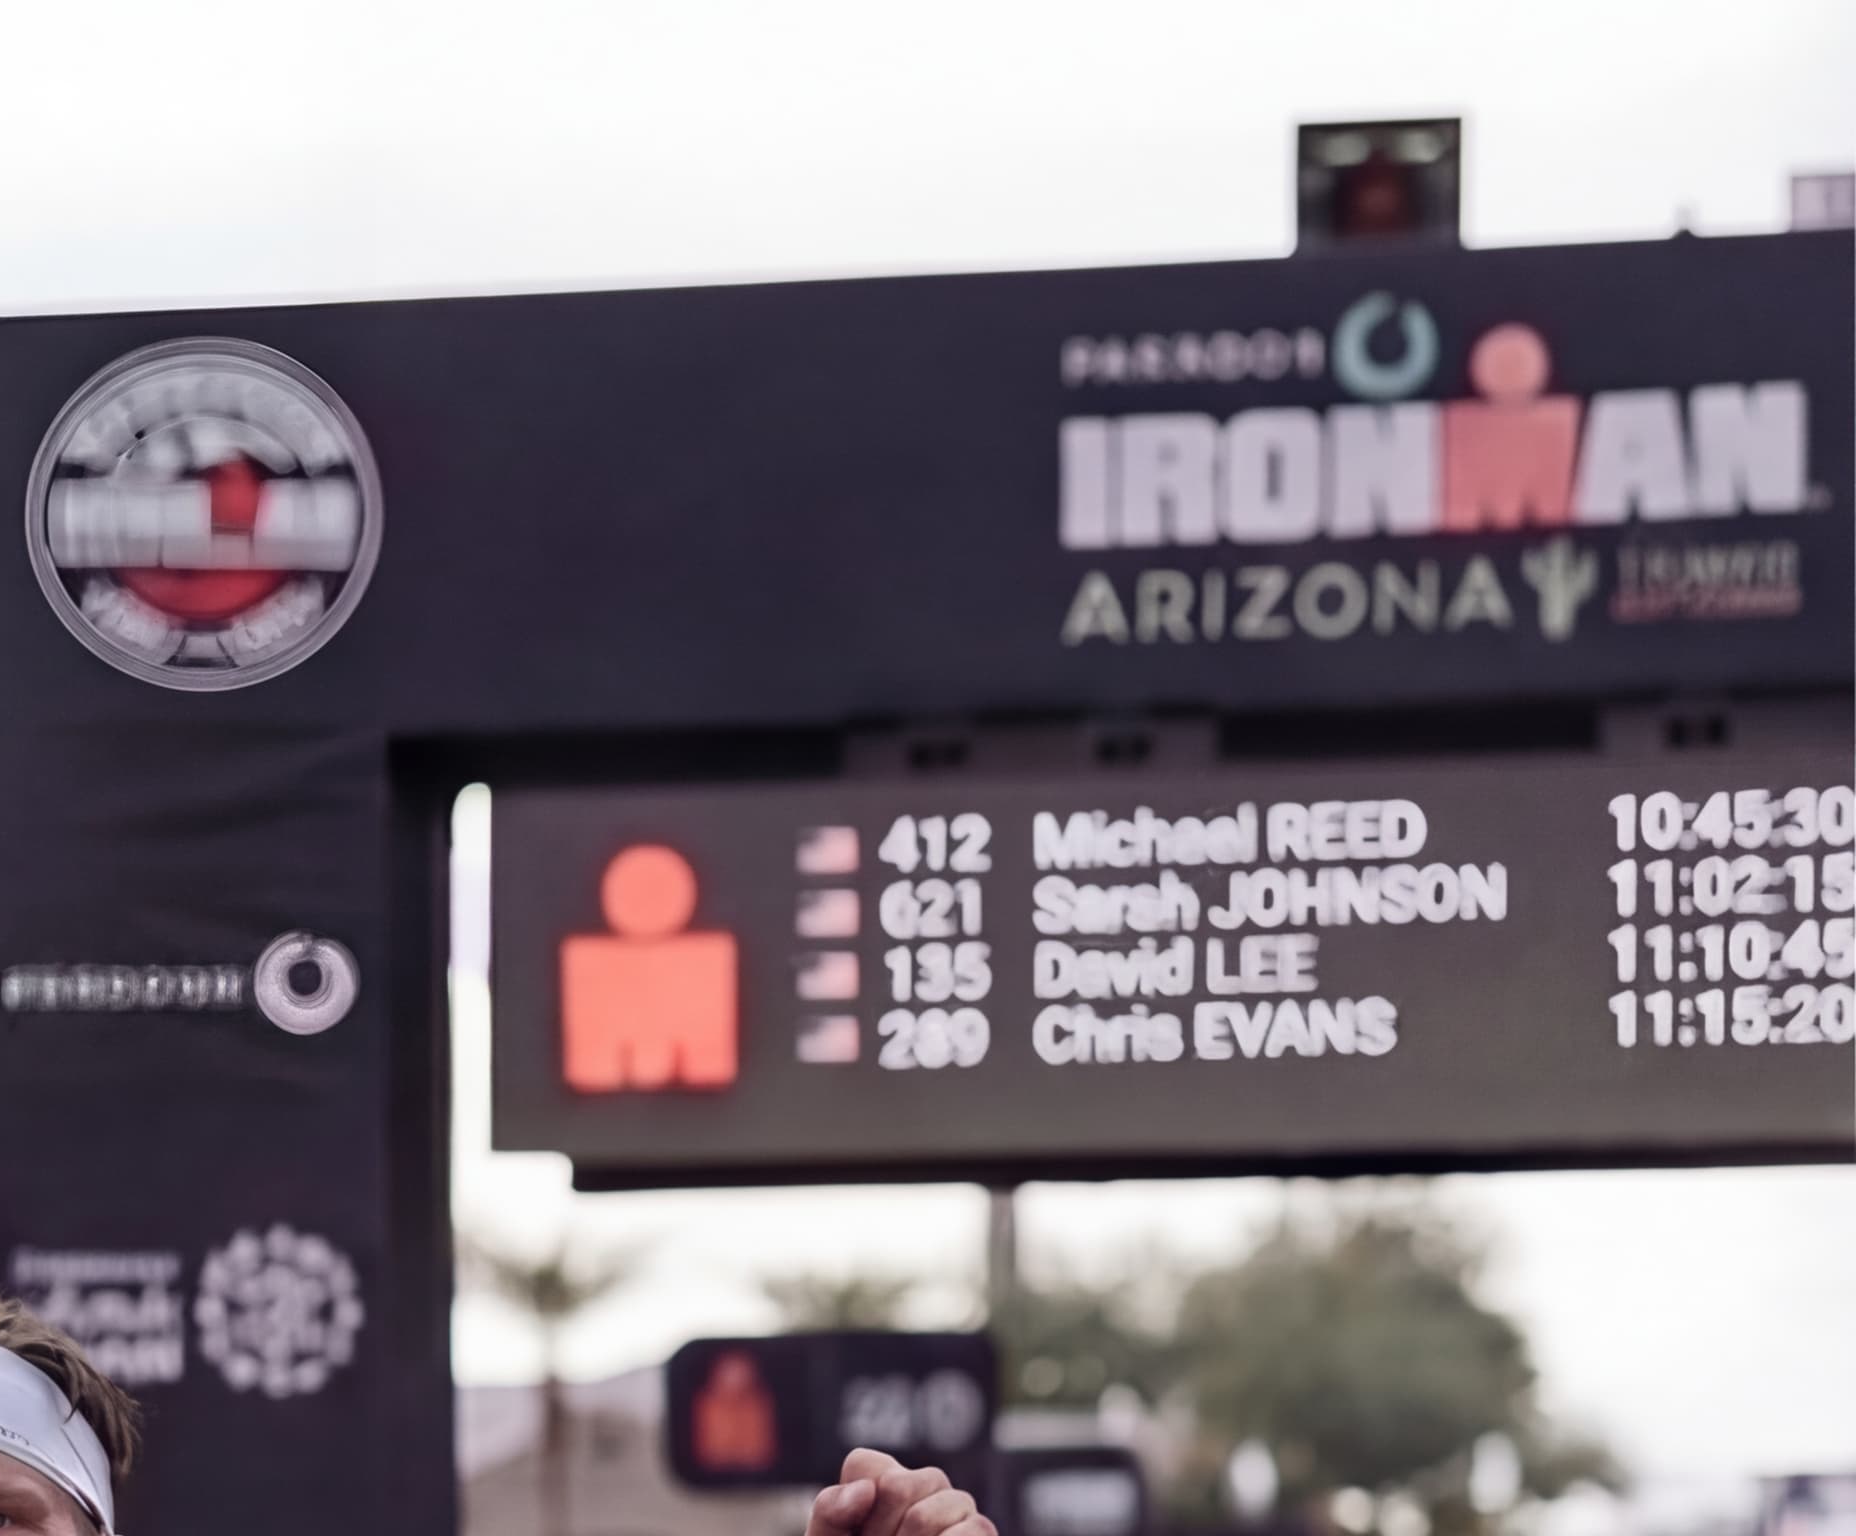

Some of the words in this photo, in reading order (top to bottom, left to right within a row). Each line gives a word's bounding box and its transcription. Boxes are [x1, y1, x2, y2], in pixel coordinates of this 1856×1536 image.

[1060, 380, 1806, 549] IRONMAN
[1060, 556, 1514, 646] ARIZONA
[879, 813, 992, 873] 412
[1266, 799, 1428, 862] REED
[1607, 786, 1855, 852] 10:45:30
[879, 878, 982, 939] 621
[1208, 862, 1508, 929] JOHNSON
[1606, 851, 1855, 918] 11:02:15
[884, 941, 992, 1002] 135
[1033, 936, 1194, 998] David
[1206, 932, 1319, 995] LEE
[1606, 917, 1855, 983] 11:10:45
[1032, 1003, 1183, 1066] Chris
[1194, 996, 1399, 1060] EVANS
[1608, 982, 1855, 1048] 11:15:20
